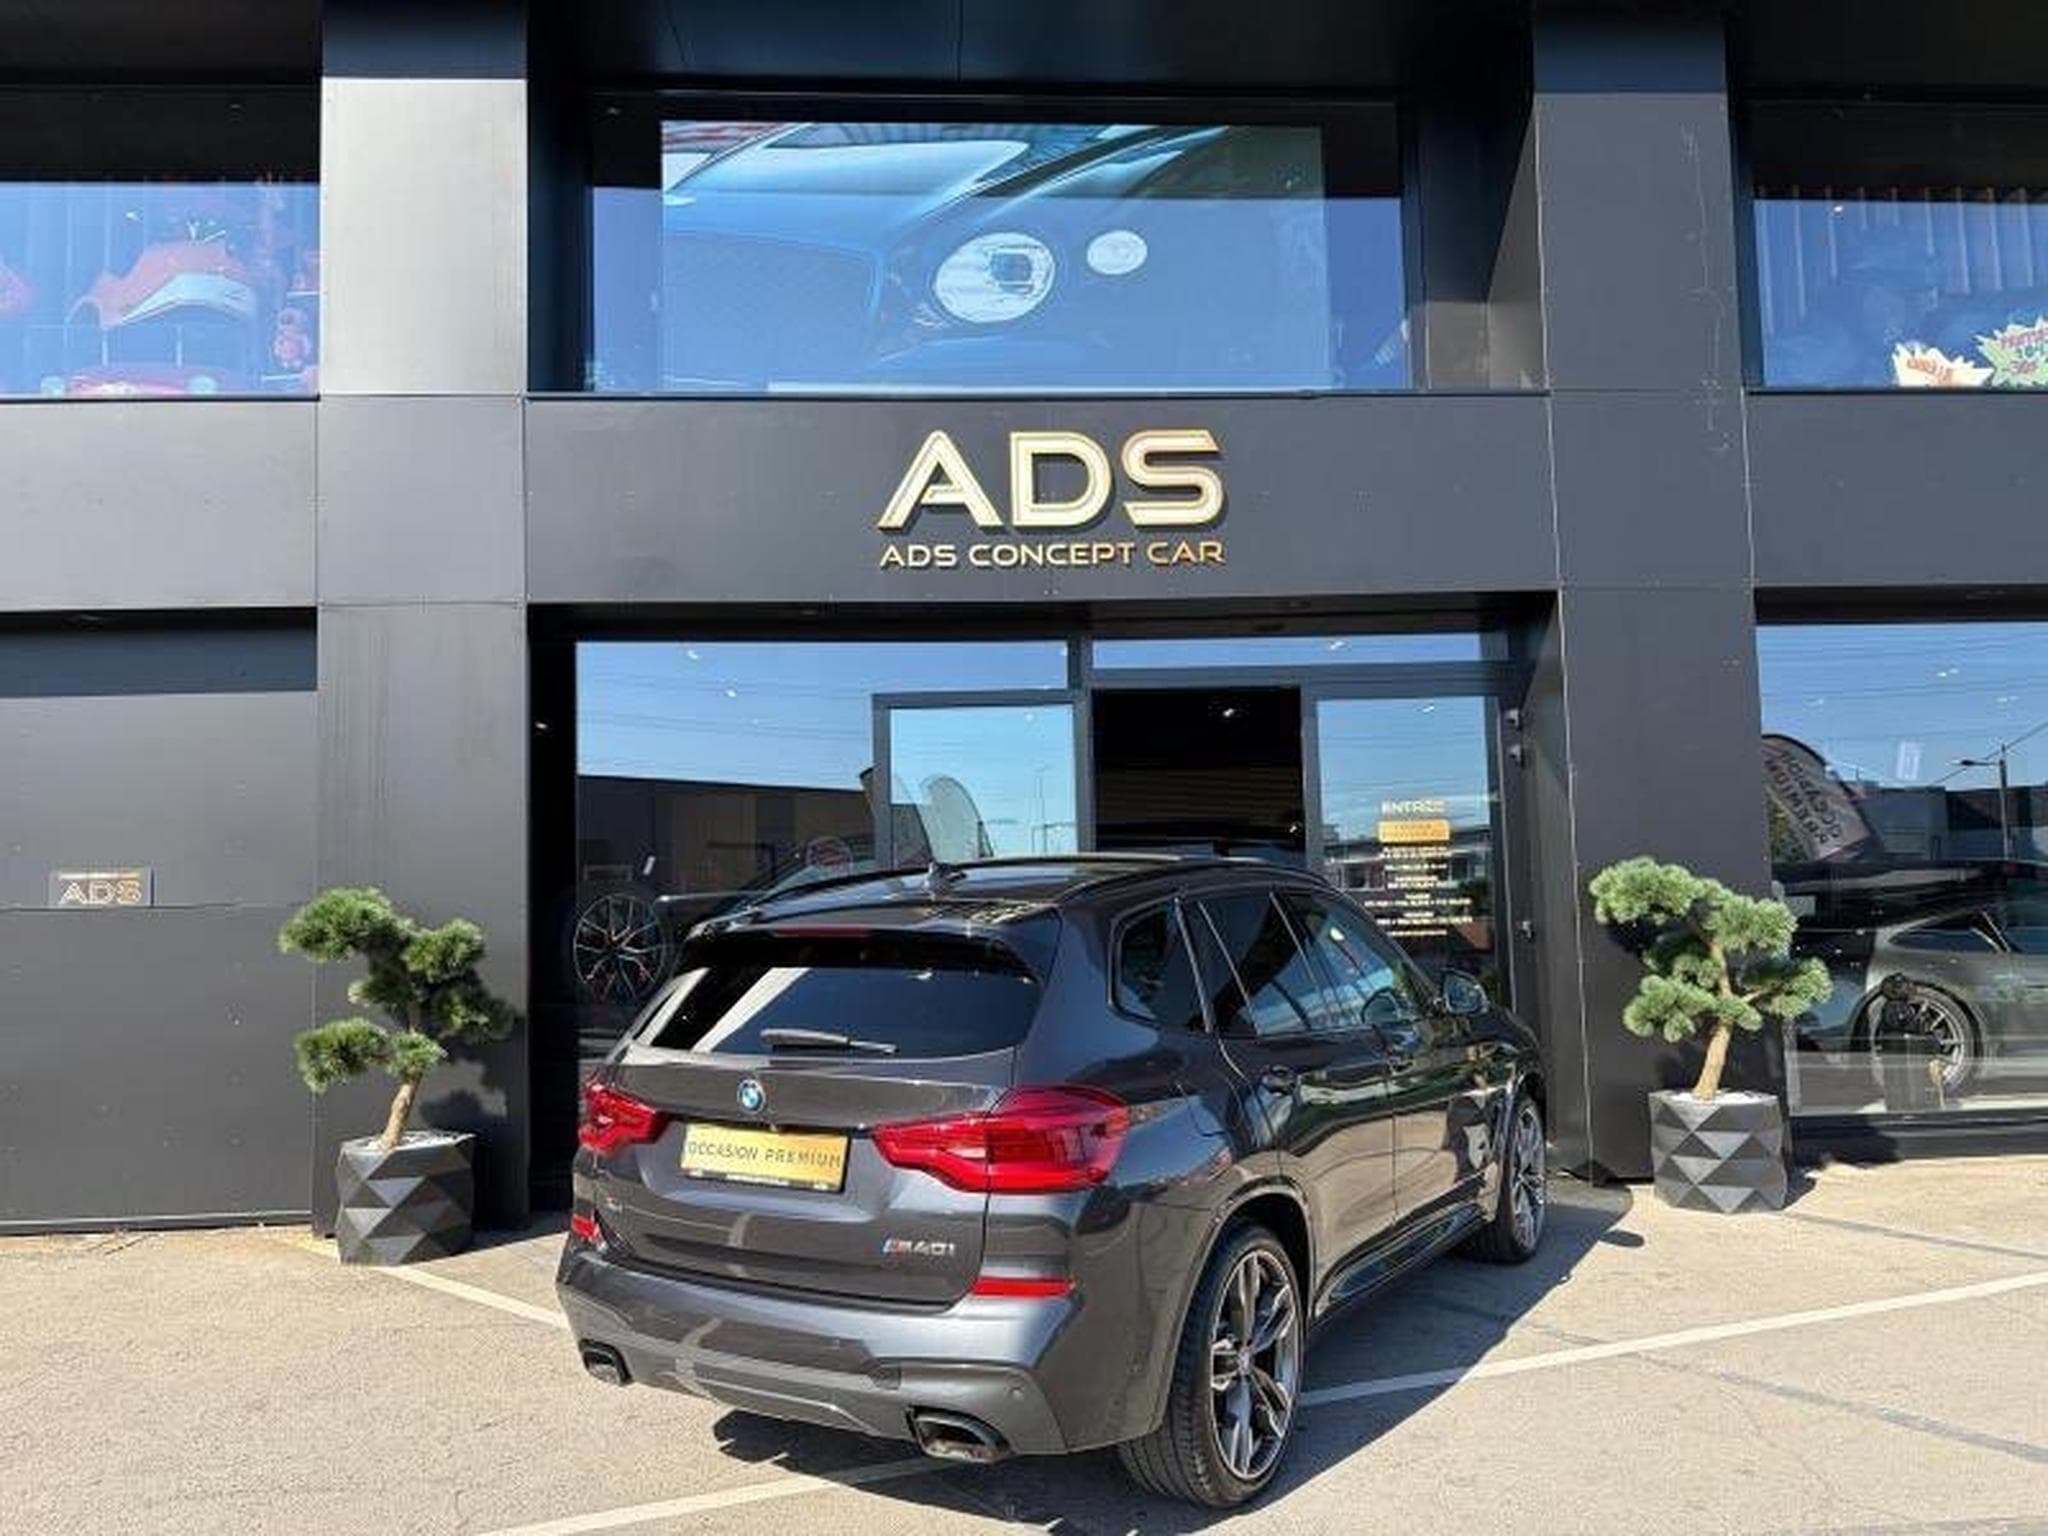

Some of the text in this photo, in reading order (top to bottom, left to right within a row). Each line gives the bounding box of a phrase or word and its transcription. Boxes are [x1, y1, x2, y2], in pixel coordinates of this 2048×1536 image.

[876, 429, 1226, 530] ADS
[879, 541, 1226, 568] ADS CONCEPT CAR
[58, 880, 143, 906] ADS
[687, 1141, 842, 1169] OCCASION PREMIUM
